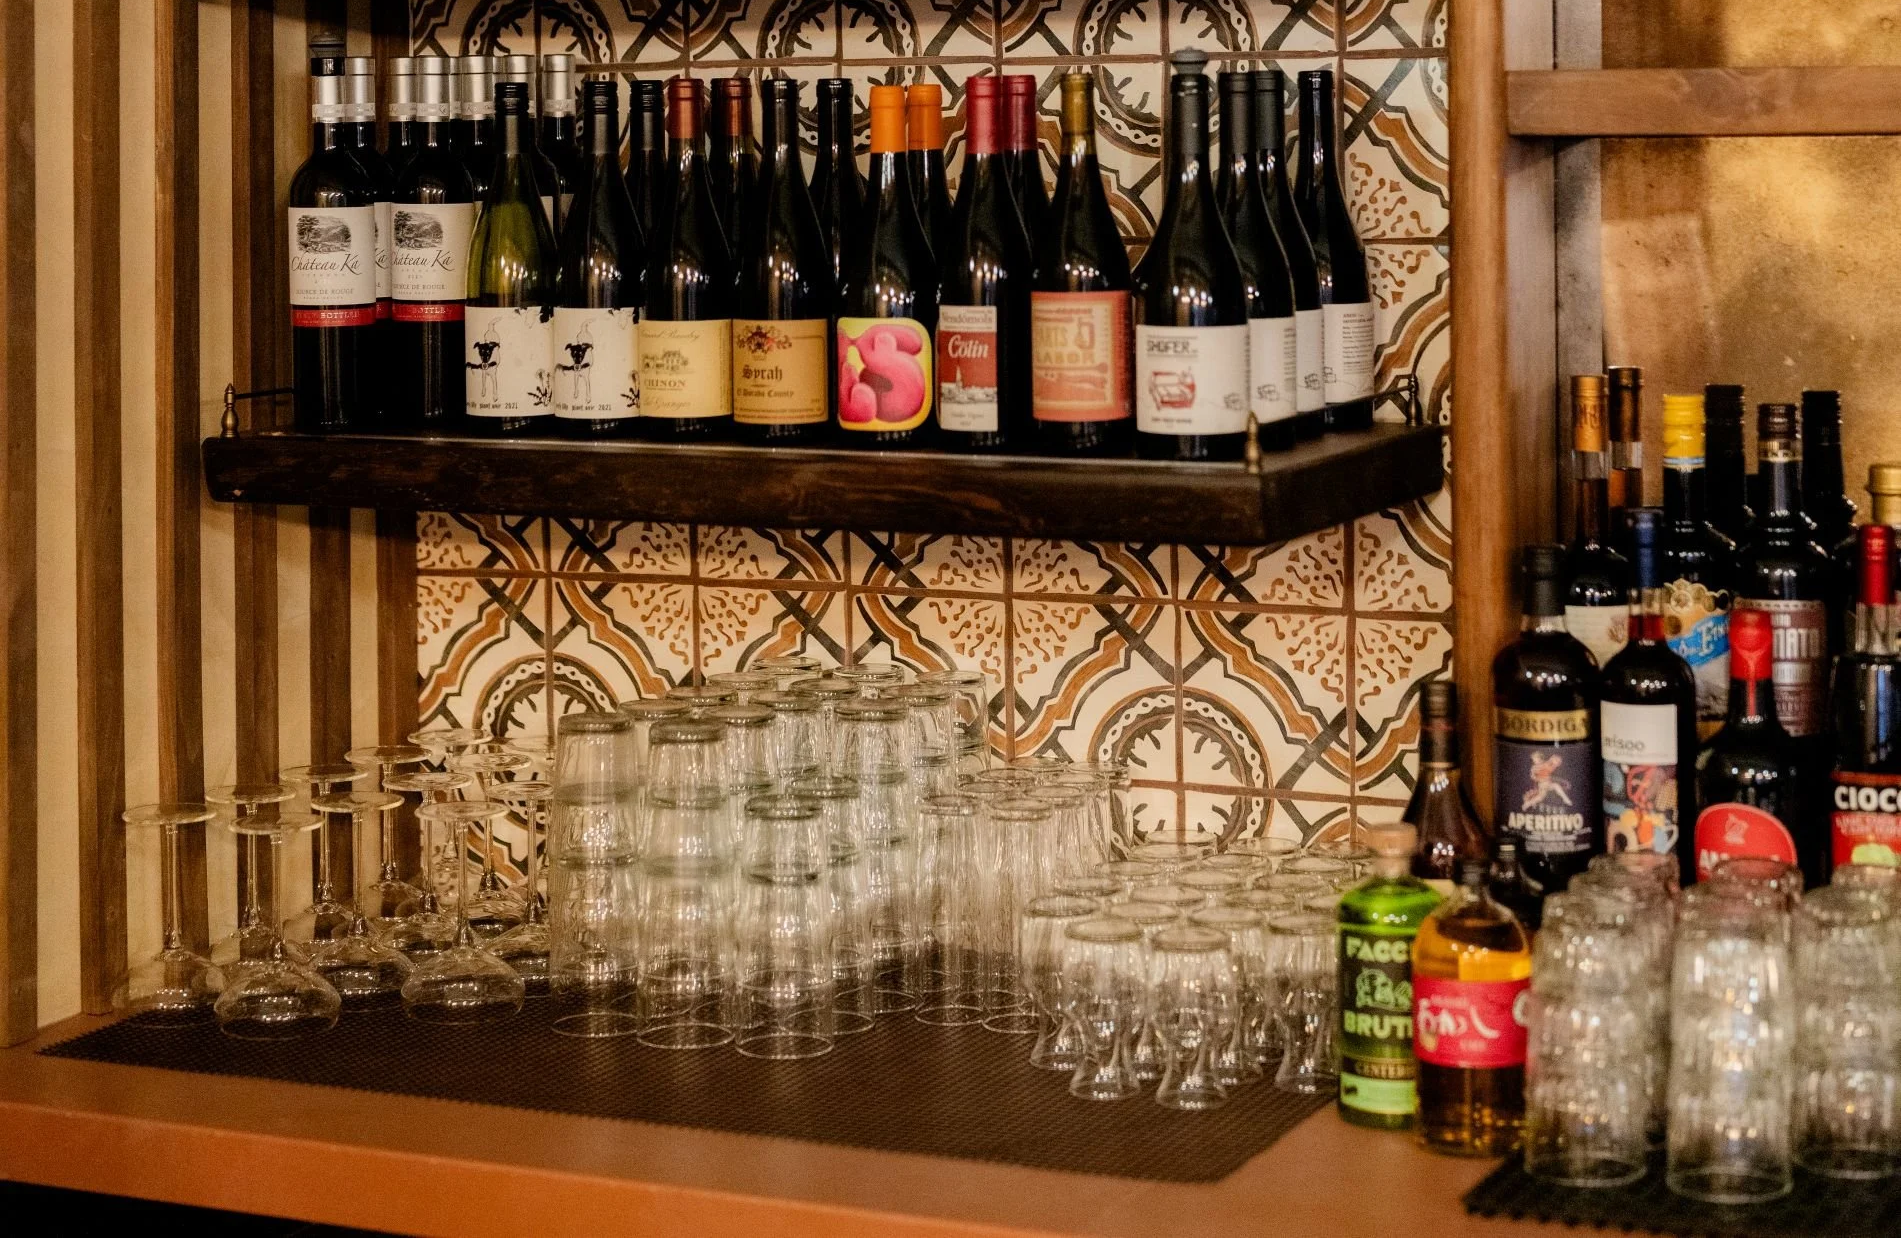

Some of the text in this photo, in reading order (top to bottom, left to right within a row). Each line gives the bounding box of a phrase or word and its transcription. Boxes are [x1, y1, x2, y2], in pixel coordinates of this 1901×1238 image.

[340, 253, 363, 276] Ka
[430, 249, 456, 272] Ka
[947, 333, 989, 359] Colin
[742, 364, 783, 382] Syrah
[1833, 784, 1901, 812] CIOC
[1508, 812, 1584, 831] APERITIVO
[1346, 936, 1410, 964] FACC
